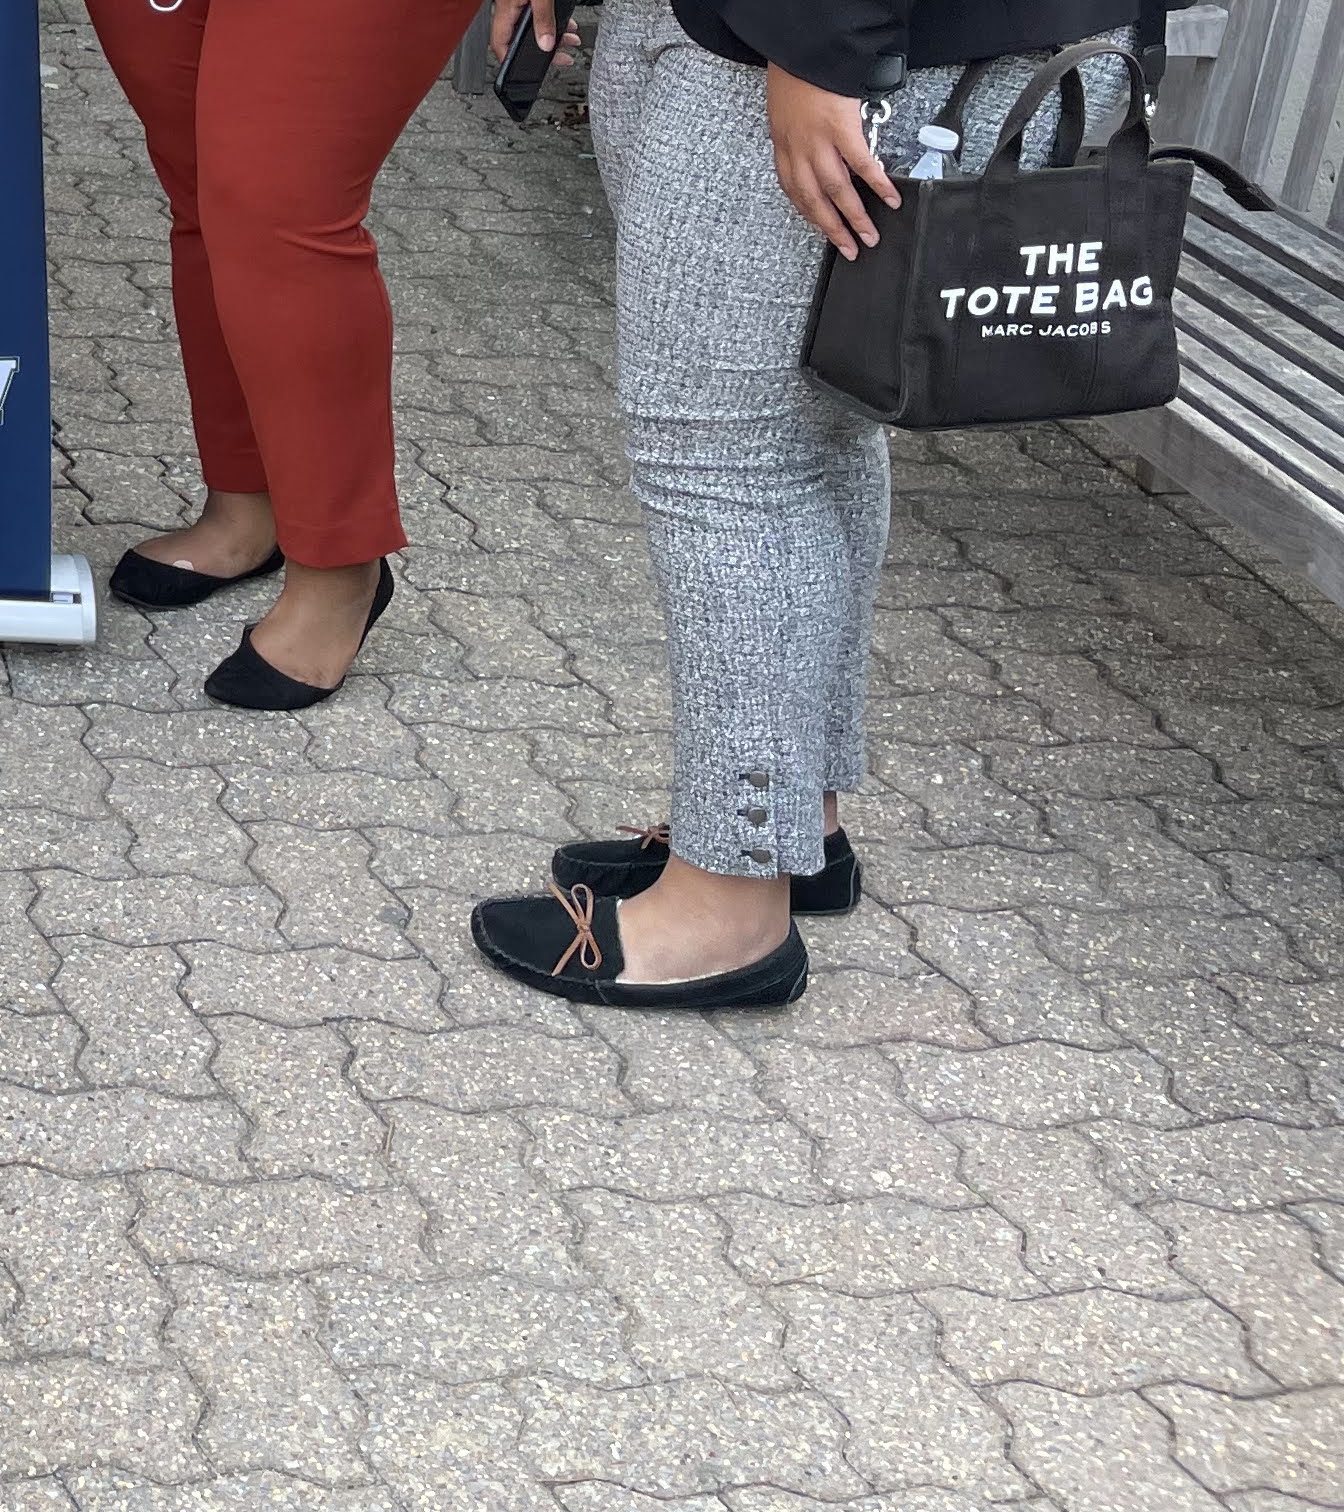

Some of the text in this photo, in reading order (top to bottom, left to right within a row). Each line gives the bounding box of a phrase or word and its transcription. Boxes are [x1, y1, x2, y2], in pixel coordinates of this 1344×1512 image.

[1019, 241, 1103, 276] THE
[940, 275, 1154, 319] TOTE BAG
[981, 320, 1112, 338] MARC JACOBS
